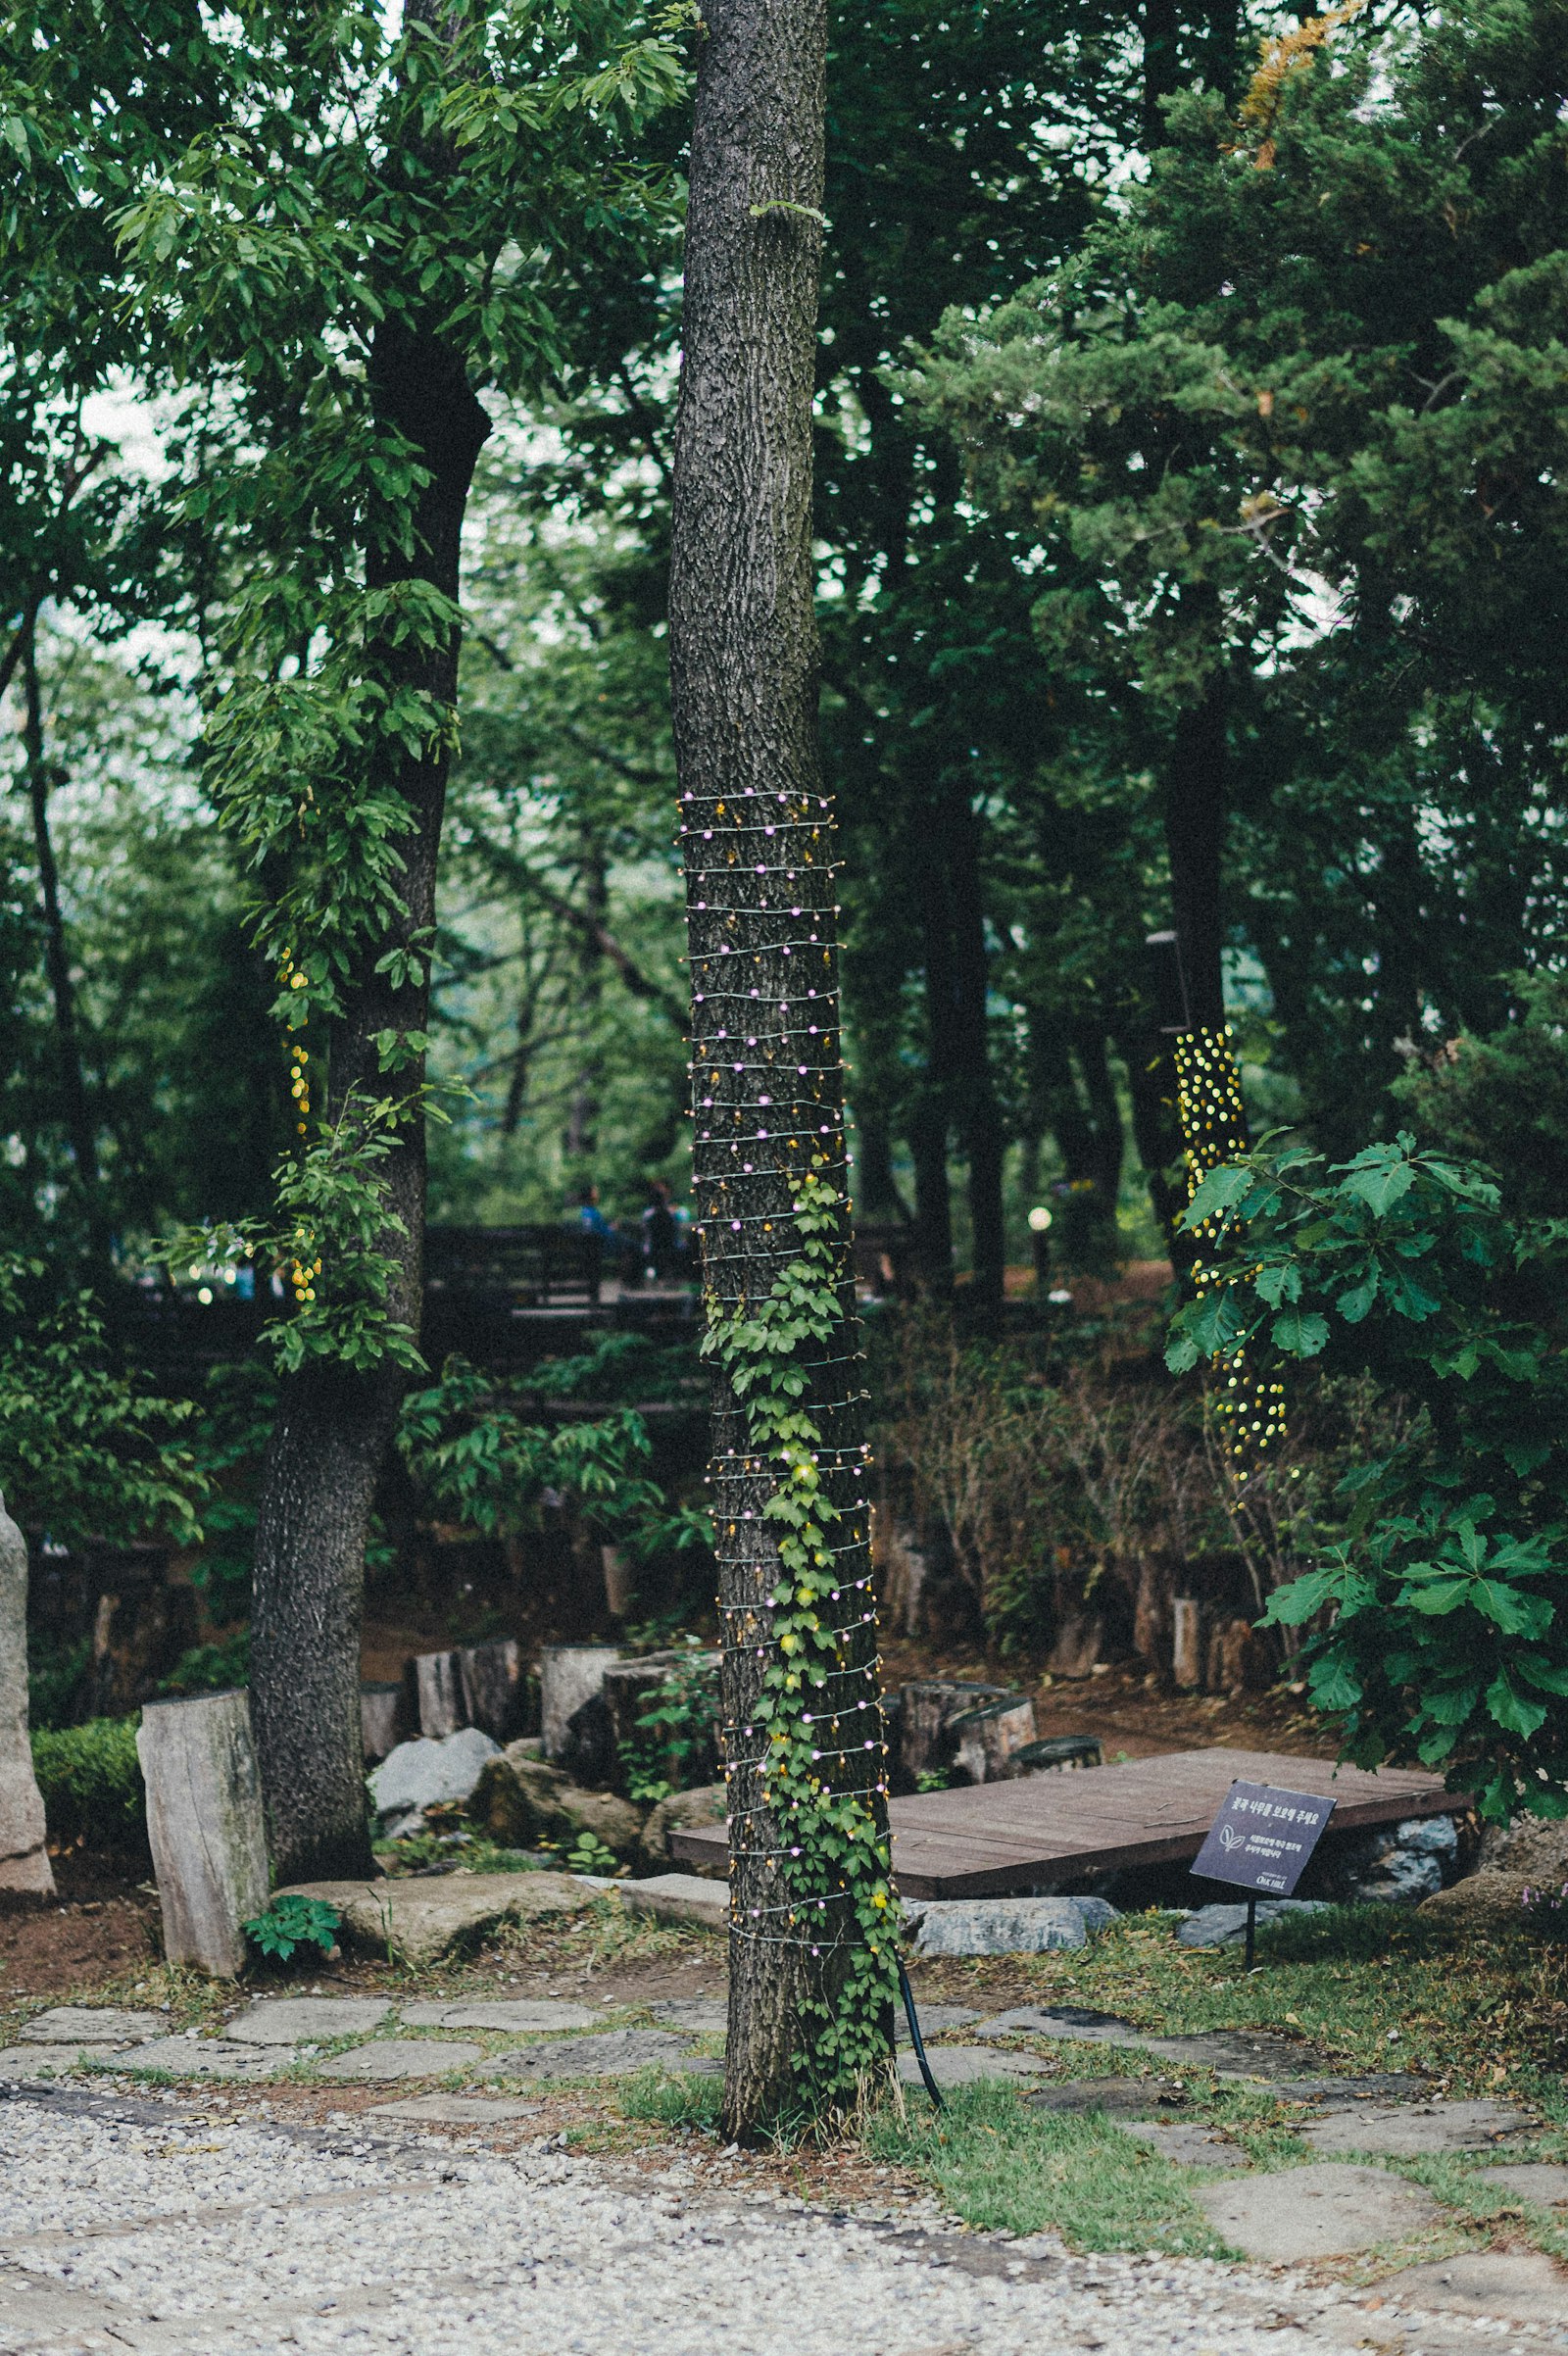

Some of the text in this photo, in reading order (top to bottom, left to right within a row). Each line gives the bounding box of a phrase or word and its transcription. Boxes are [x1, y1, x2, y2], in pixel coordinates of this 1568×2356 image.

[1250, 1800, 1273, 1817] 나무를
[1272, 1805, 1297, 1821] 보호해
[1296, 1810, 1319, 1825] 주세요
